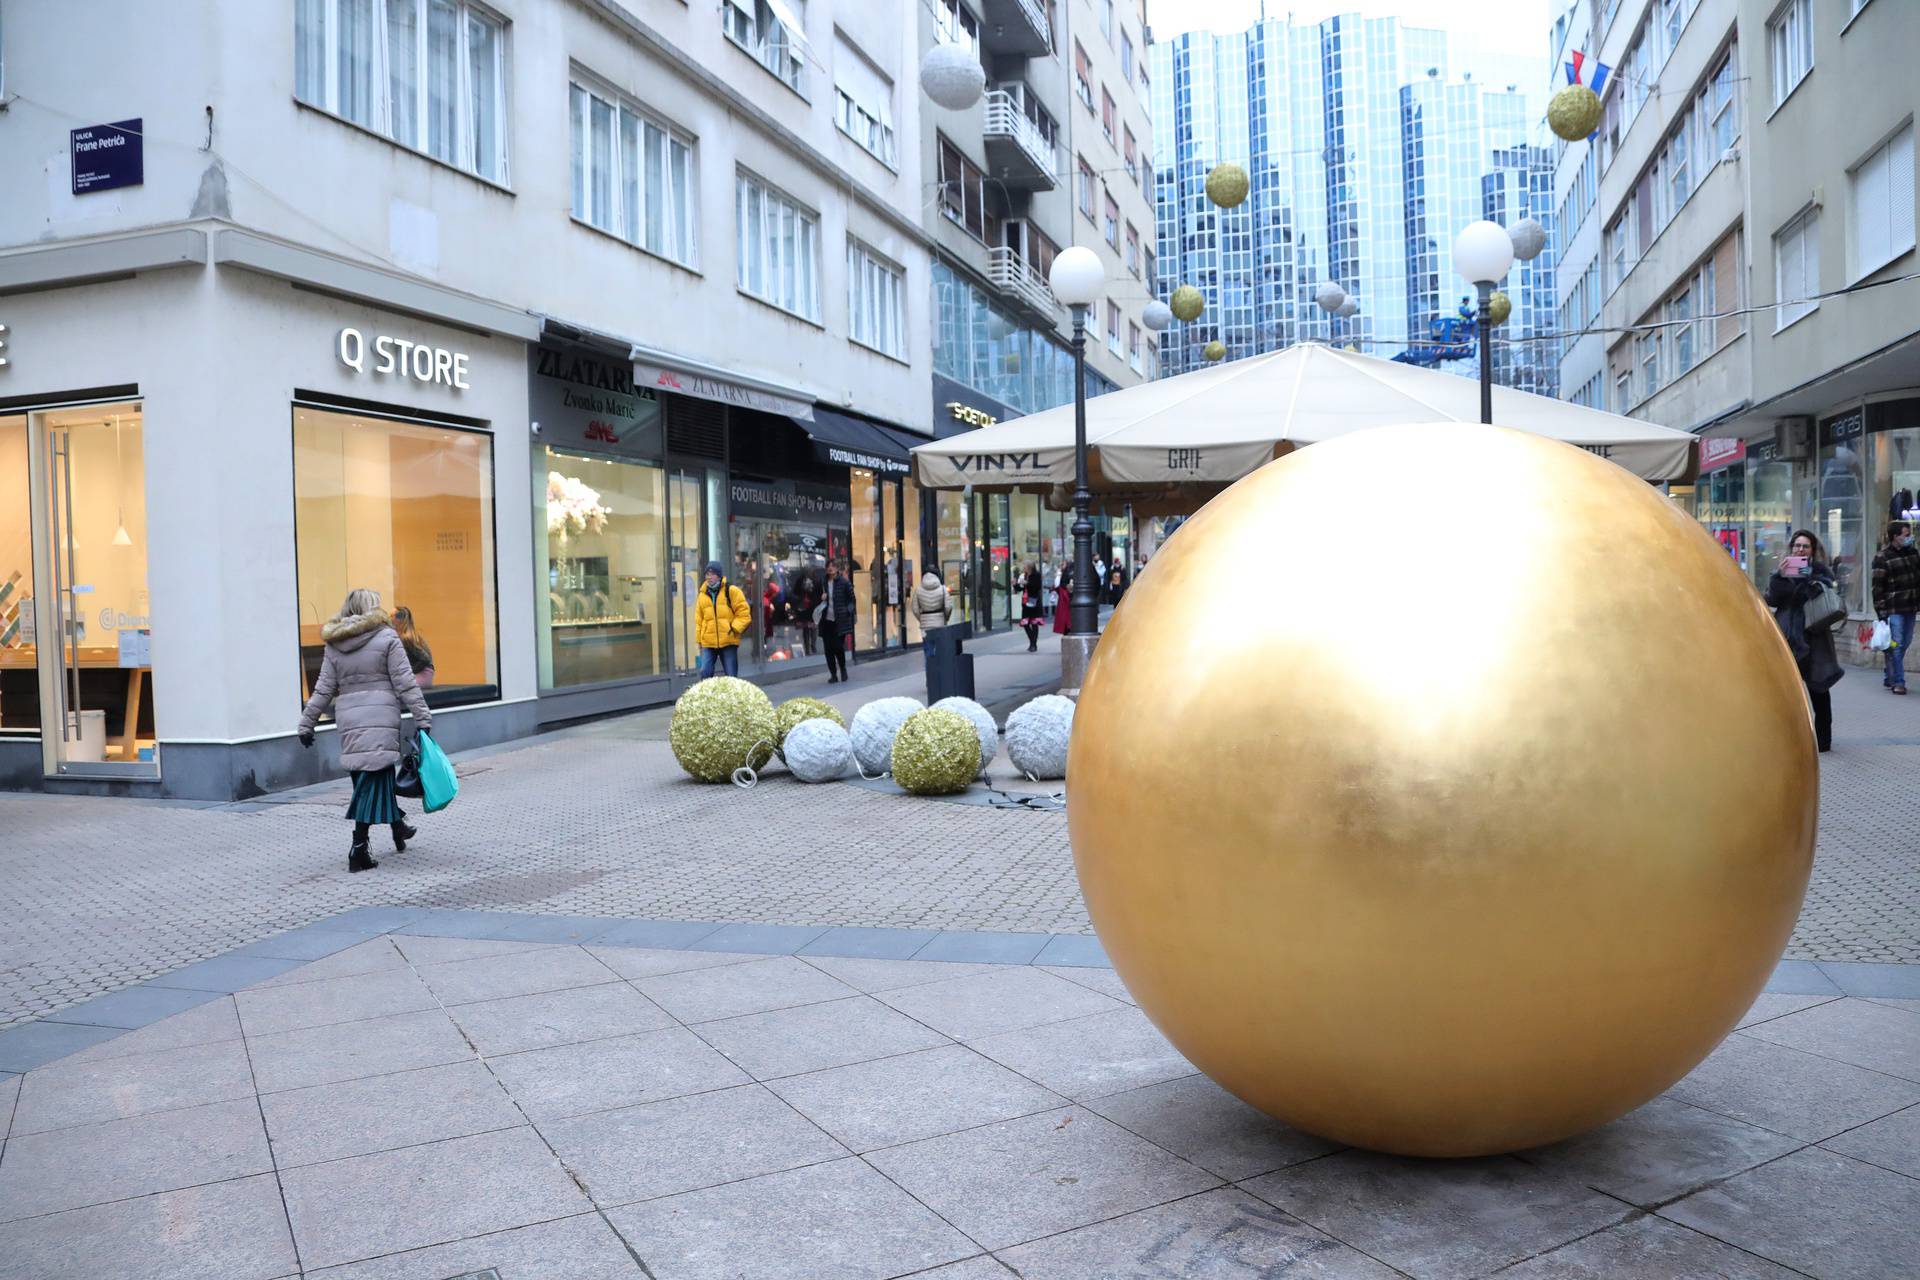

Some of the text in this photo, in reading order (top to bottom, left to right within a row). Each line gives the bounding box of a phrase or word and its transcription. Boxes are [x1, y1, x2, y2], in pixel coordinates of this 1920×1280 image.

[75, 132, 93, 140] ULICA
[76, 134, 125, 152] Frane Petrića
[340, 327, 470, 389] Q STORE
[563, 387, 635, 420] Zvonko Marić
[829, 448, 857, 465] FOOTBALL
[857, 453, 867, 466] FAN
[866, 456, 881, 469] SHOP
[947, 452, 1052, 472] VINYL
[731, 486, 772, 505] FOOTBALL
[772, 491, 787, 506] FAN
[788, 494, 807, 508] SHOP
[807, 496, 815, 512] by
